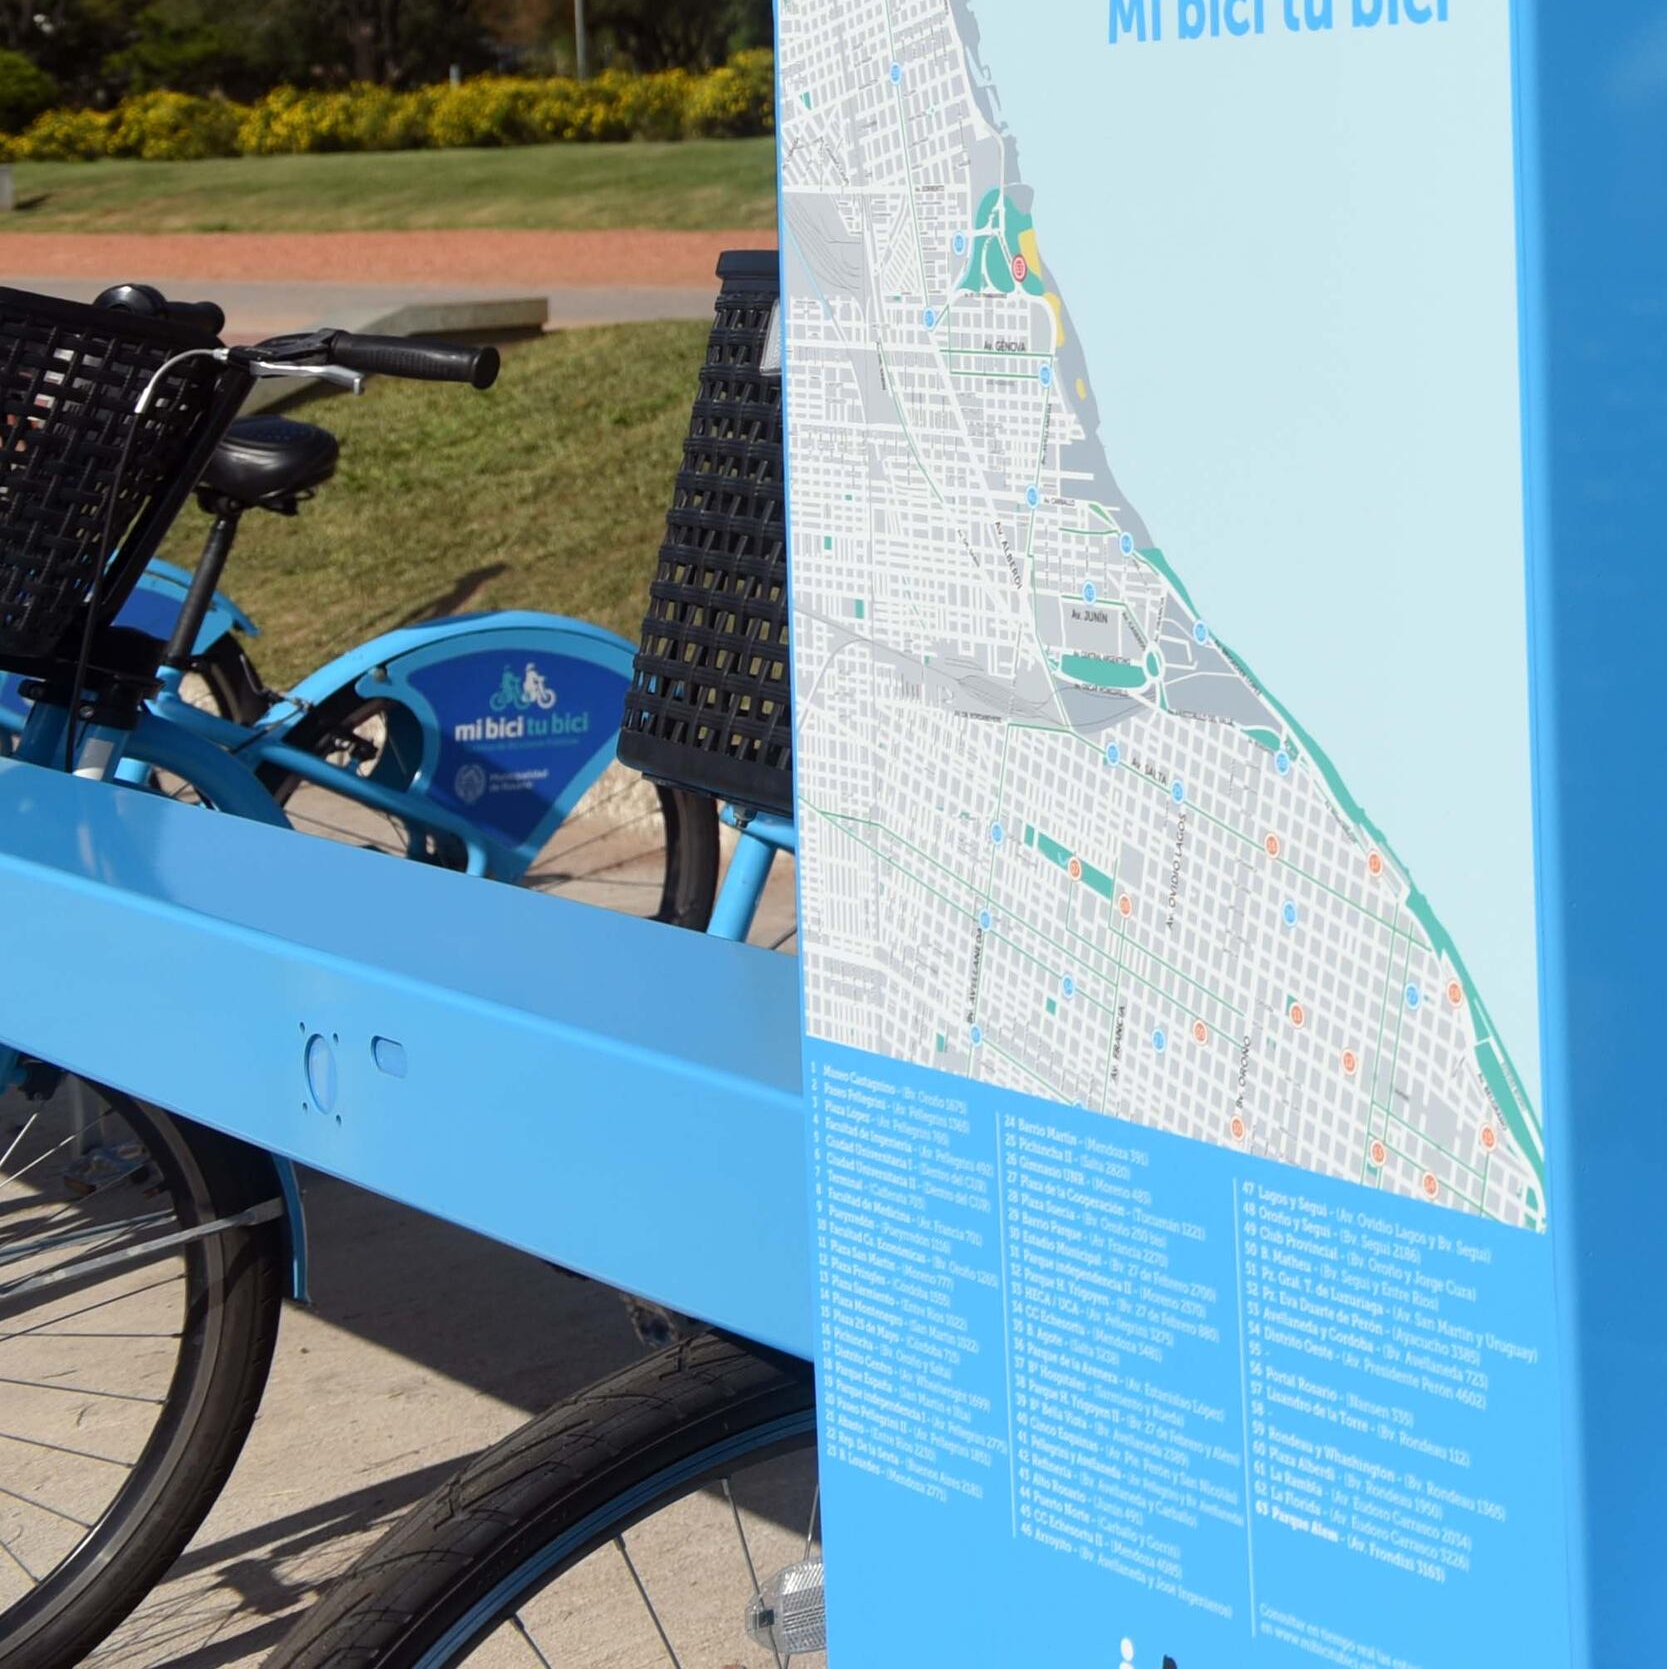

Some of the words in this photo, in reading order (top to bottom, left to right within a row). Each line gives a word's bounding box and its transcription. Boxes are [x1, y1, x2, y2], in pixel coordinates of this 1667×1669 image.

[1001, 540, 1022, 590] ALBERDI
[455, 719, 482, 741] mi
[486, 715, 525, 739] bici
[527, 717, 548, 736] tu
[551, 712, 588, 734] bici
[1174, 813, 1187, 857] LAGOS
[1168, 860, 1181, 908] OVIDIO
[1112, 1006, 1125, 1059] FRANCIA
[1241, 1179, 1254, 1196] 47
[1258, 1183, 1288, 1208] Lagos
[1357, 1212, 1393, 1236] Ovidio
[1395, 1222, 1426, 1248] Lagos
[1243, 1200, 1255, 1216] 48
[1243, 1220, 1257, 1236] 49
[1259, 1225, 1284, 1244] Club
[1285, 1232, 1338, 1261] Provincial
[1413, 1269, 1444, 1295] Jorge
[1272, 1248, 1312, 1273] Matheu
[1382, 1281, 1409, 1302] Entre
[1279, 1290, 1297, 1309] Eva
[1299, 1296, 1335, 1321] Duarte
[1336, 1307, 1349, 1325] de
[1315, 1281, 1329, 1299] de
[1414, 1311, 1435, 1331] San
[1485, 1332, 1537, 1365] Uruguay)
[1262, 1305, 1318, 1336] Avellaneda
[1404, 1349, 1463, 1382] Avellaneda
[1263, 1325, 1302, 1350] Distrito
[1363, 1357, 1419, 1388] Presidente
[1265, 1365, 1295, 1388] Portal
[1312, 1400, 1326, 1419] de
[1338, 1409, 1368, 1433] Torre
[1271, 1504, 1309, 1535] Parque
[1310, 1519, 1338, 1544] Alem
